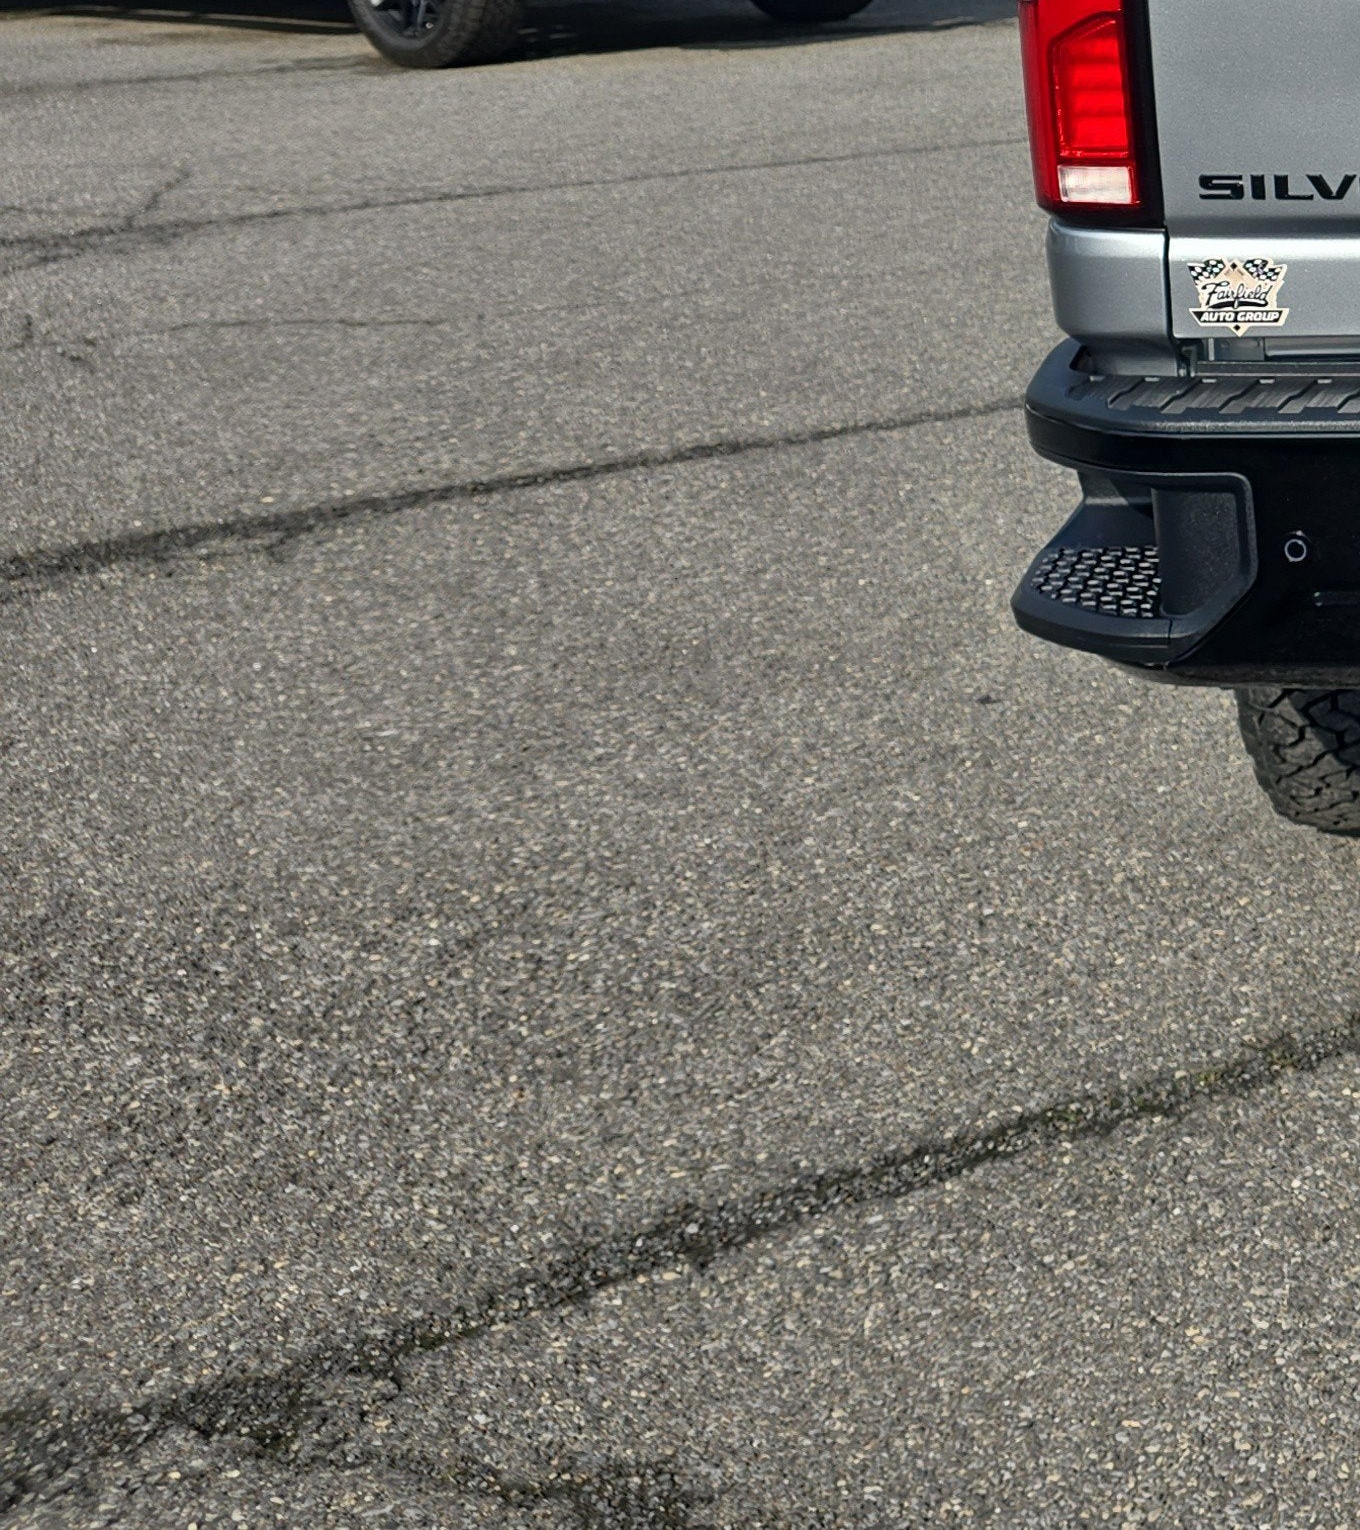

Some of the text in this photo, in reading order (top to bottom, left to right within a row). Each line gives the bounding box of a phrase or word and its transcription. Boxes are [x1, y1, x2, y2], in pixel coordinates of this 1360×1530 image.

[1201, 280, 1274, 308] Fairfield
[1200, 311, 1280, 322] AUTO GROUP
